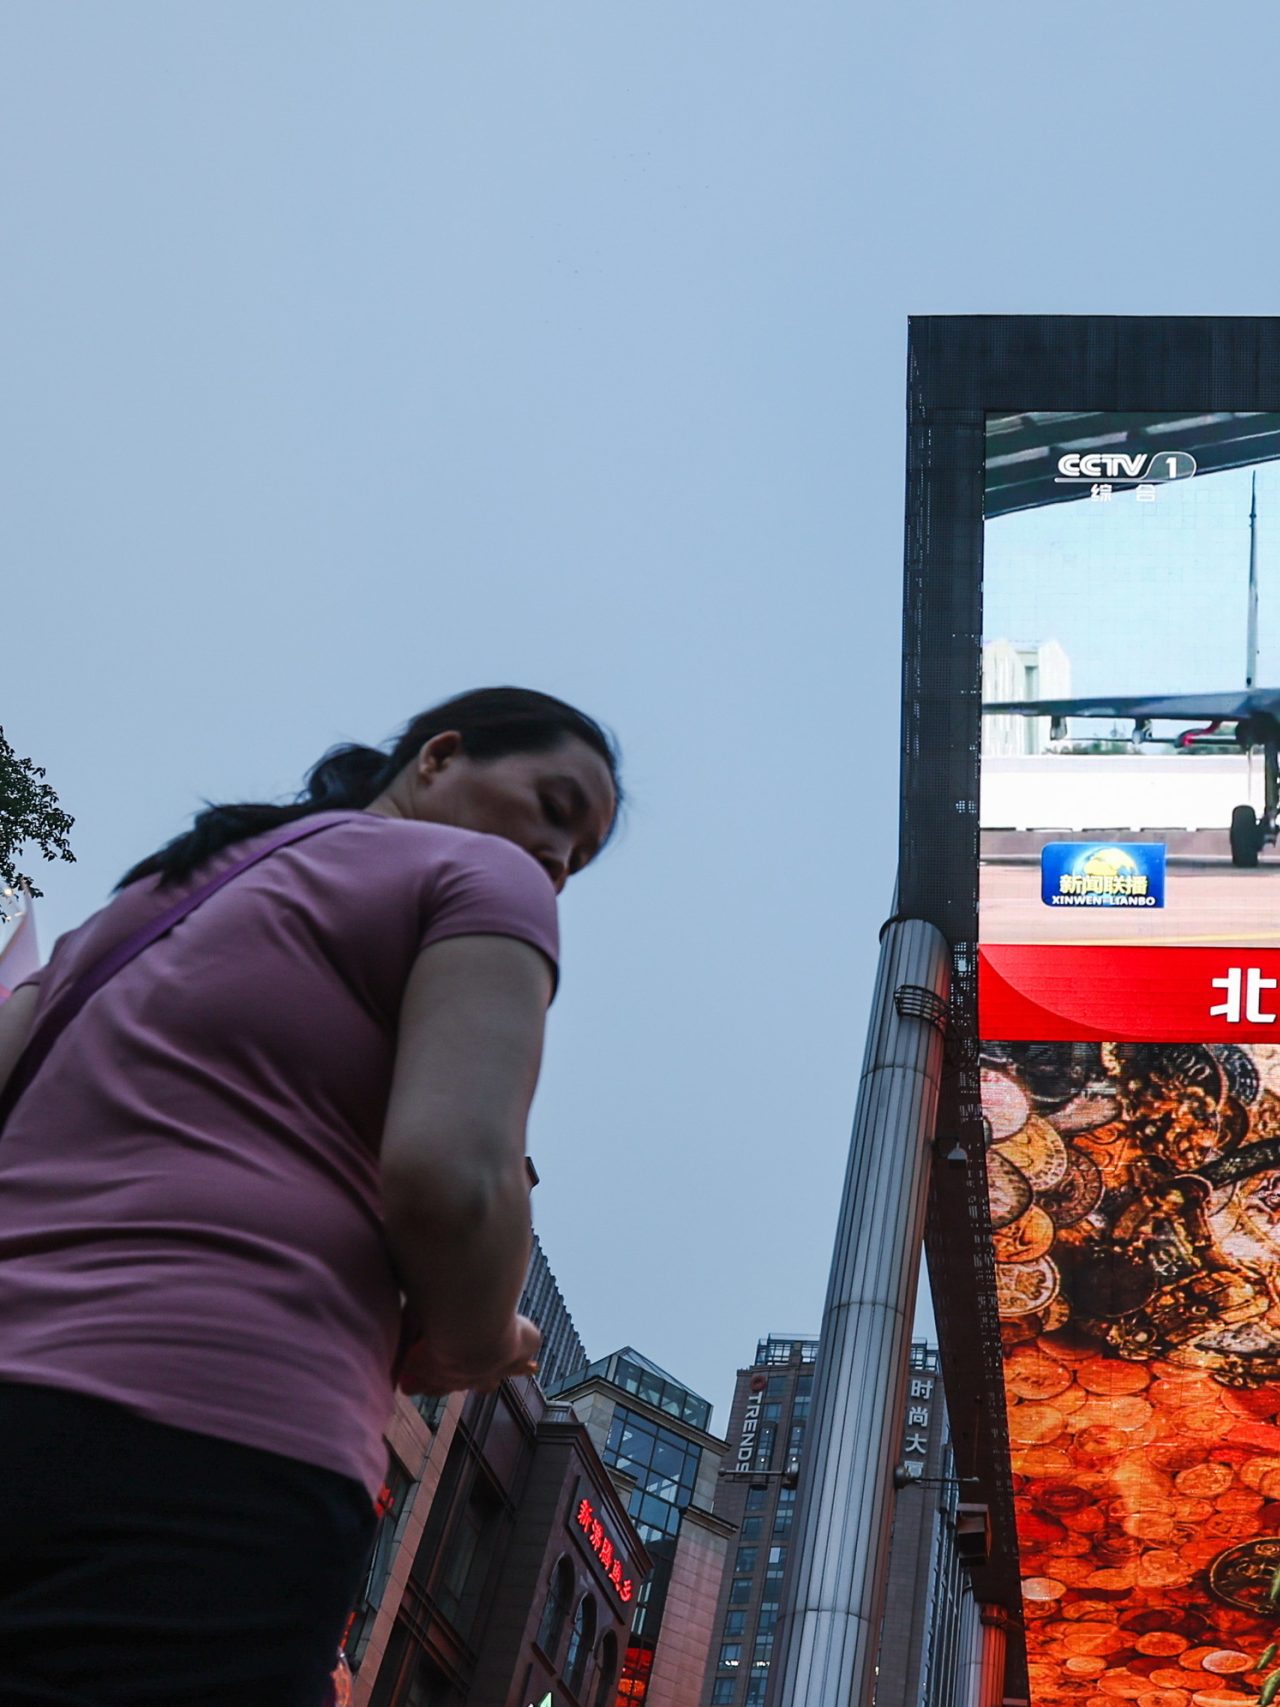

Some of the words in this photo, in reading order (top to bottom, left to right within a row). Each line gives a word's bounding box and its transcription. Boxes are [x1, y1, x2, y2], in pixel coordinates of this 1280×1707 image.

[1058, 454, 1147, 477] CCTV
[1166, 457, 1177, 478] 1
[1091, 484, 1155, 501] 综合
[1060, 875, 1147, 894] 新闻联播
[1052, 896, 1100, 905] XINWEN
[1111, 896, 1155, 905] LIANBO
